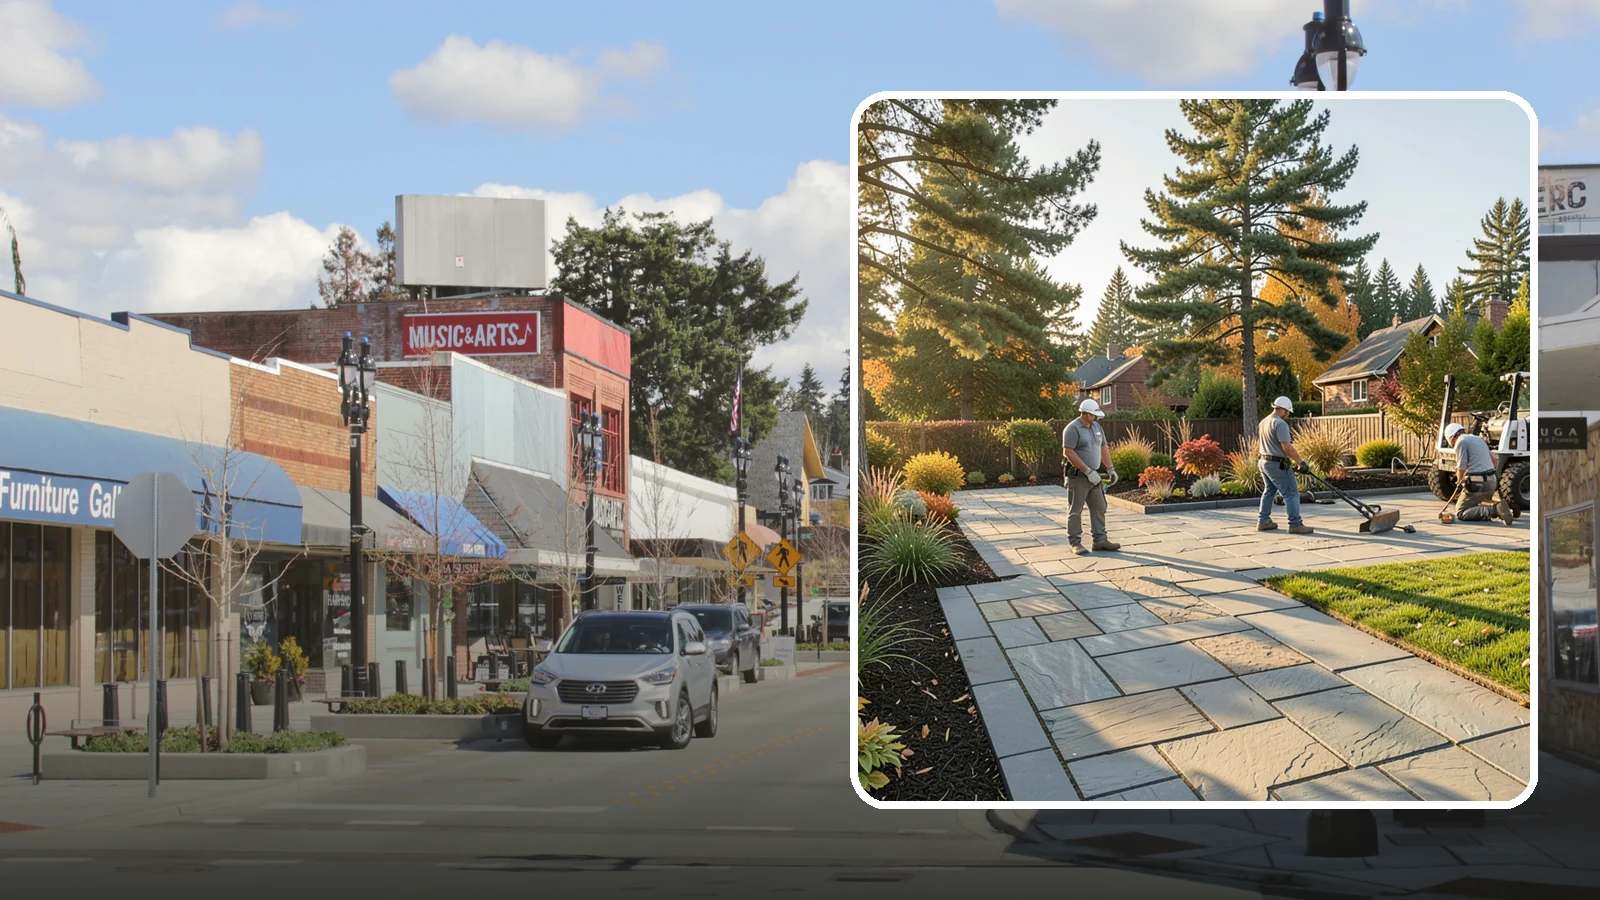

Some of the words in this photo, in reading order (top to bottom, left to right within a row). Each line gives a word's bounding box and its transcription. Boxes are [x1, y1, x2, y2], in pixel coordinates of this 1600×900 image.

[409, 323, 520, 349] MUSIC&ARTS
[0, 471, 80, 516] Furniture
[89, 482, 122, 519] Gal
[453, 562, 479, 575] SUSHI
[327, 594, 342, 607] HAIR
